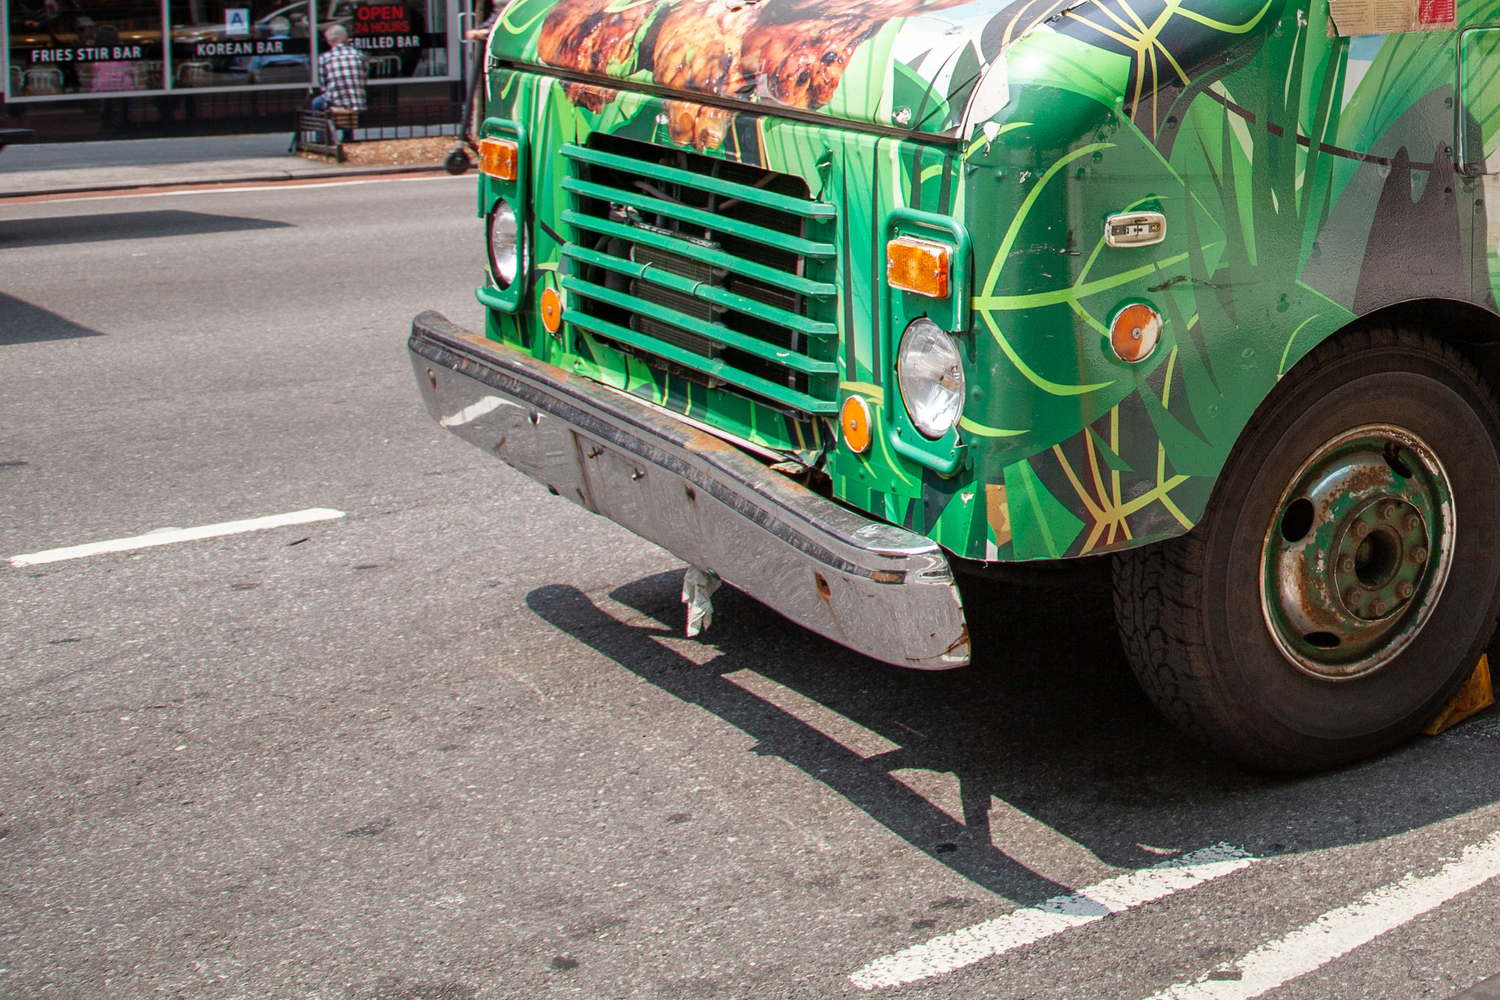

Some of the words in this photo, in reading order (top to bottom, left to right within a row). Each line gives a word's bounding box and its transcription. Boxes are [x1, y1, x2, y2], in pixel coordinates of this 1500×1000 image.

[231, 12, 245, 27] A
[357, 6, 404, 21] OPEN
[354, 22, 369, 35] 24
[371, 20, 410, 34] HOURS
[197, 42, 253, 57] KOREAN
[256, 41, 284, 55] BAR
[397, 35, 421, 49] BAR
[31, 49, 73, 63] FRIES
[76, 47, 110, 61] STIR
[112, 45, 142, 60] BAR
